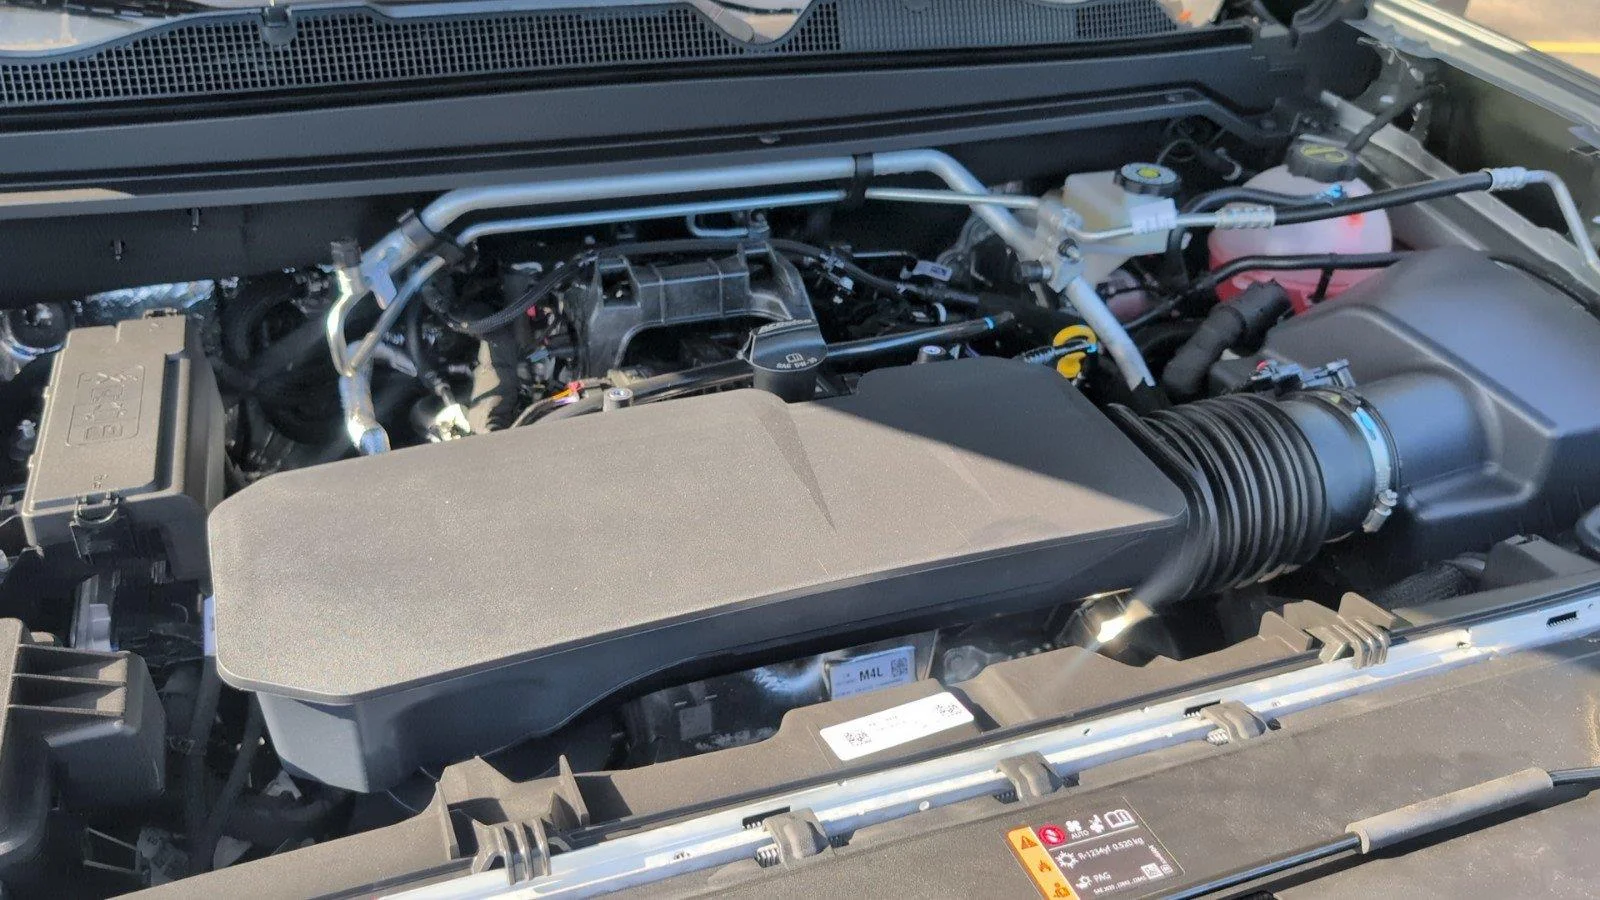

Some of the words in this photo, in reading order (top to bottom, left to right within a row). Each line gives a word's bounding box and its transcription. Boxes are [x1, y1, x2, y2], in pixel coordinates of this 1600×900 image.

[859, 667, 884, 681] M4L
[1070, 830, 1090, 840] AUTO
[1077, 844, 1111, 860] R-1234yf
[1112, 839, 1133, 851] 0.520
[1132, 837, 1145, 846] kg
[1092, 872, 1112, 883] PAG
